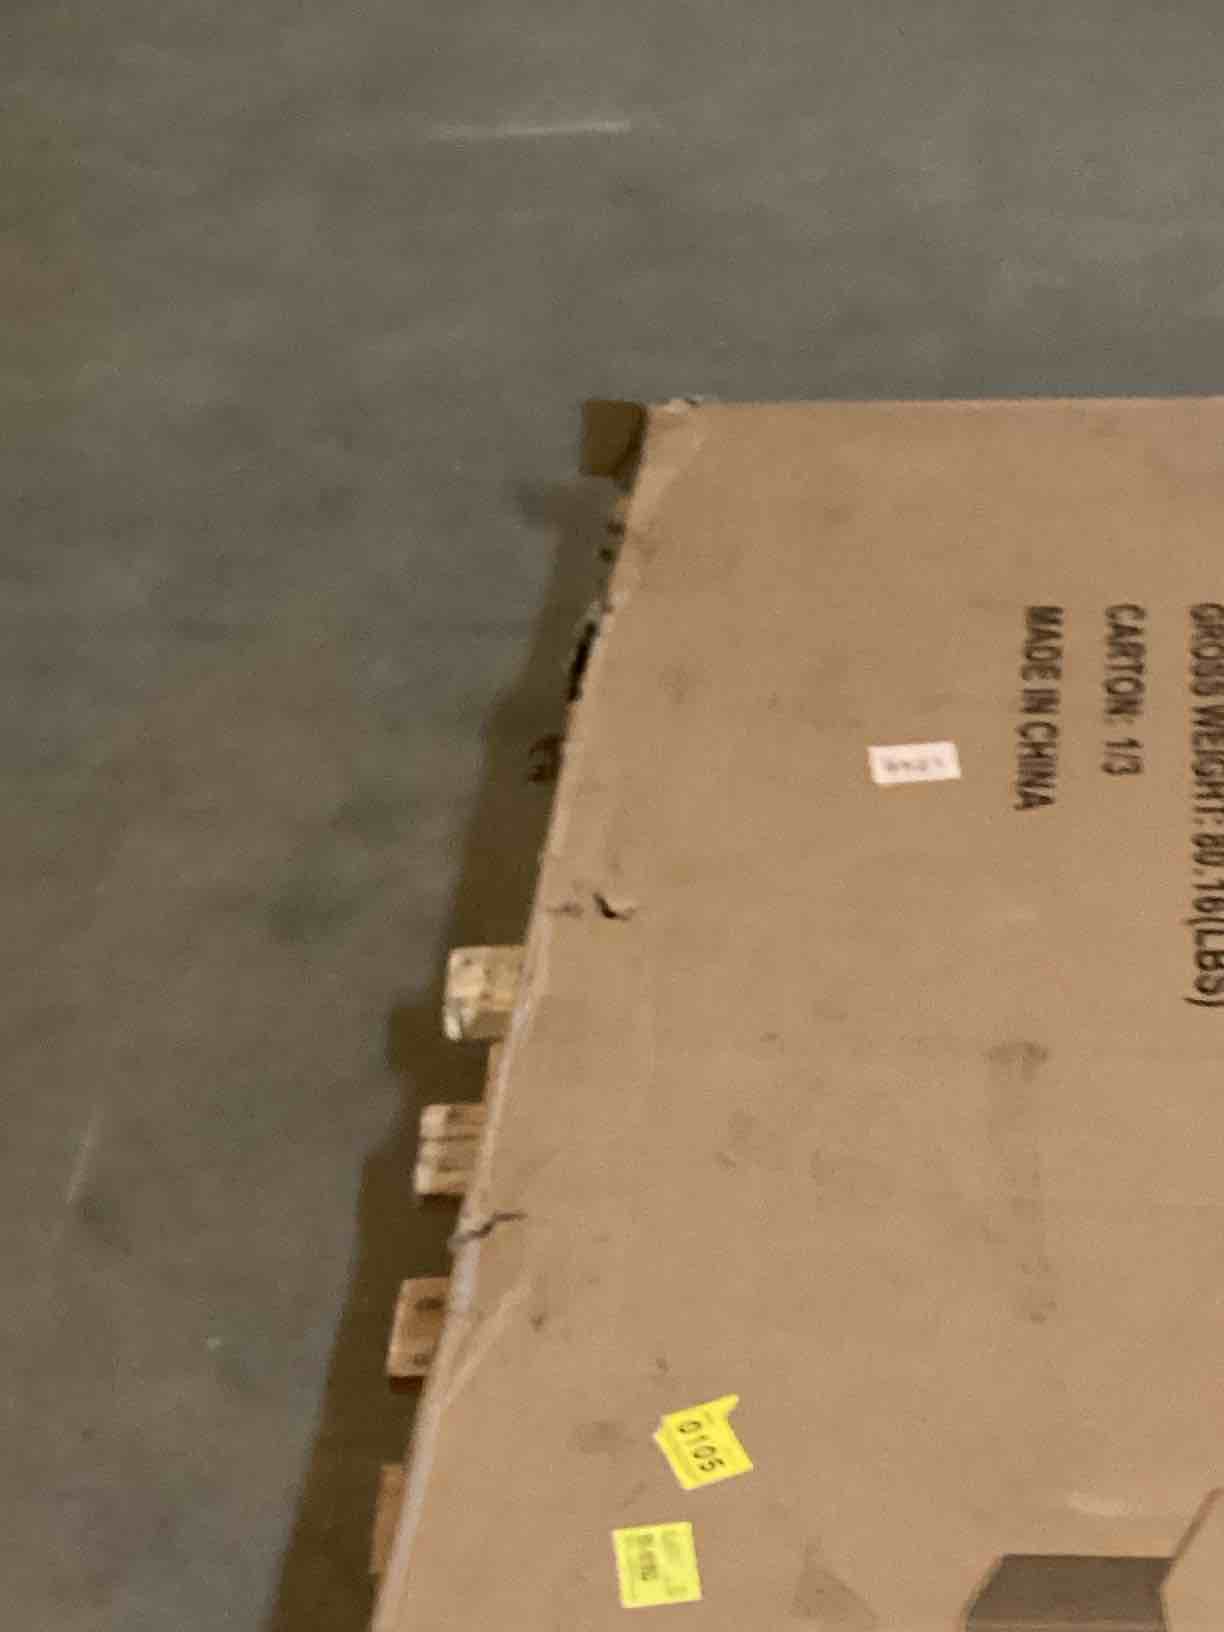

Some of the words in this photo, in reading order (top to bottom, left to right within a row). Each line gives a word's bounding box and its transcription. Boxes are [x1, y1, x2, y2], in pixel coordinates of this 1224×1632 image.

[1020, 605, 1062, 681] MADE
[1102, 603, 1146, 725] CARTON:
[1019, 689, 1059, 714] IN
[1013, 721, 1057, 811] CHINA
[1100, 737, 1144, 777] 1/3
